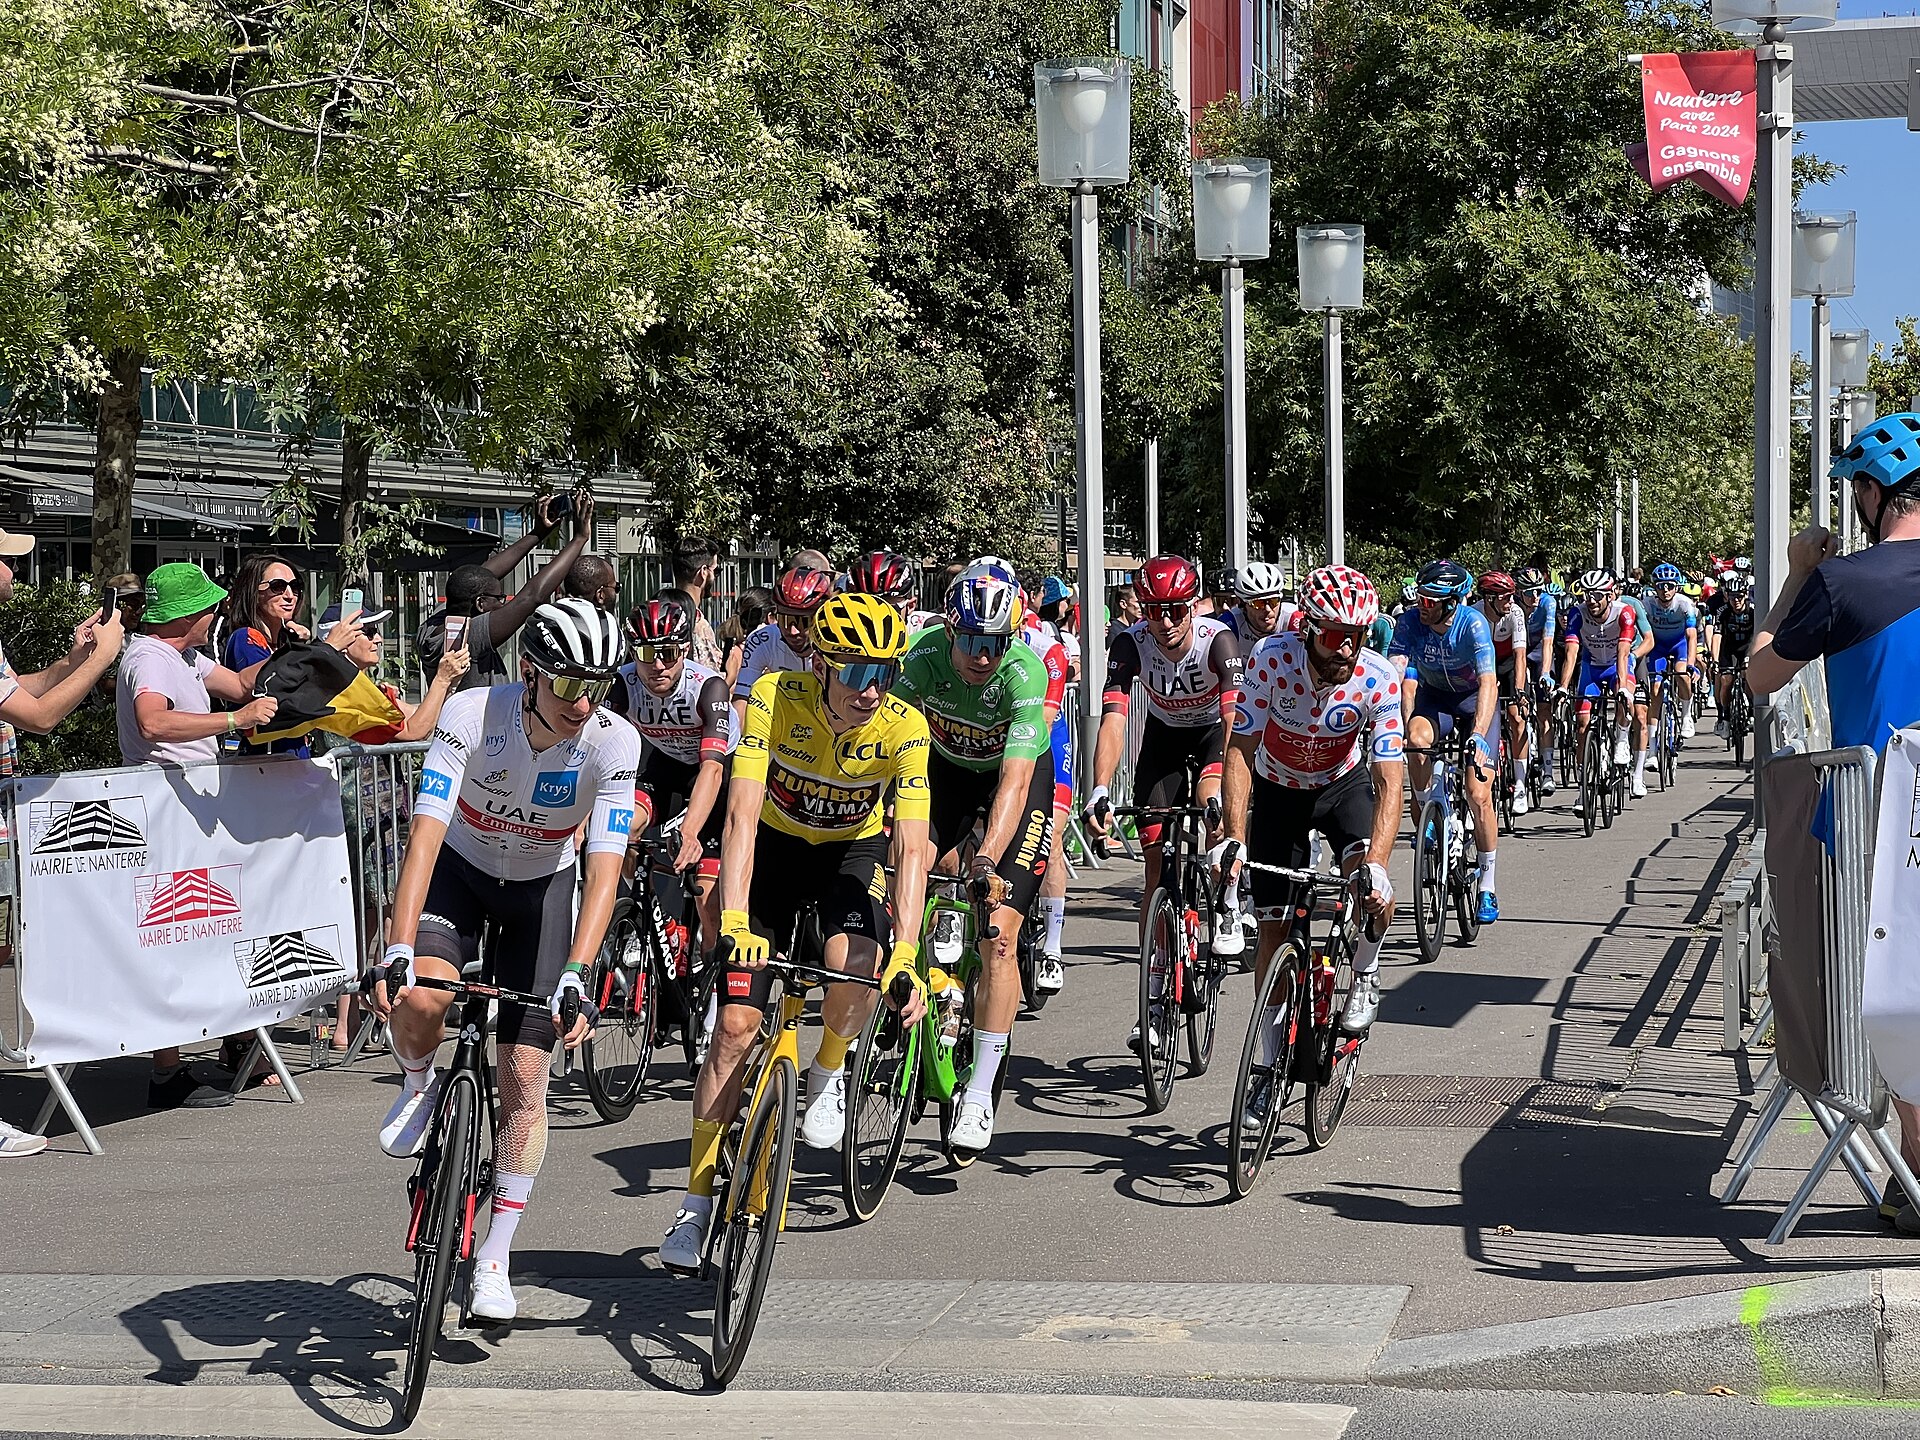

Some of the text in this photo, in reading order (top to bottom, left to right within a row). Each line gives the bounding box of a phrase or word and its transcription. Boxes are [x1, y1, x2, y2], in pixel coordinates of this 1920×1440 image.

[1654, 89, 1744, 109] Nanterre
[1680, 111, 1716, 122] avec
[1660, 117, 1741, 138] Paris 2024
[1660, 145, 1741, 165] Gagnons
[1662, 160, 1742, 186] ensemble
[536, 621, 562, 651] MET
[1424, 643, 1450, 657] ISRAEL
[899, 675, 917, 691] tini
[1148, 670, 1209, 697] UAE
[884, 697, 907, 719] LCL
[926, 695, 958, 710] satini
[637, 706, 695, 726] UAE
[929, 712, 1006, 740] JUMBO
[434, 723, 466, 751] antini
[486, 734, 505, 748] Krys
[1279, 733, 1347, 750] Cofidis
[566, 743, 587, 760] Krys
[777, 743, 818, 764] santini
[841, 741, 890, 762] LCL
[421, 774, 446, 791] rys
[539, 781, 569, 798] Krys
[773, 769, 872, 802] JUMBO
[485, 799, 549, 827] UAE
[802, 796, 871, 815] VISMA
[480, 814, 544, 838] Emirates
[615, 811, 634, 827] Kr
[1015, 809, 1046, 872] JUMBO
[30, 856, 73, 877] MAIRIE
[88, 850, 148, 873] NANTERRE
[138, 917, 243, 948] MAIRIE DE NANTERRE
[420, 914, 457, 931] antini
[728, 980, 749, 988] HEMA
[248, 989, 281, 1009] MAIRIE
[284, 986, 298, 1001] DE
